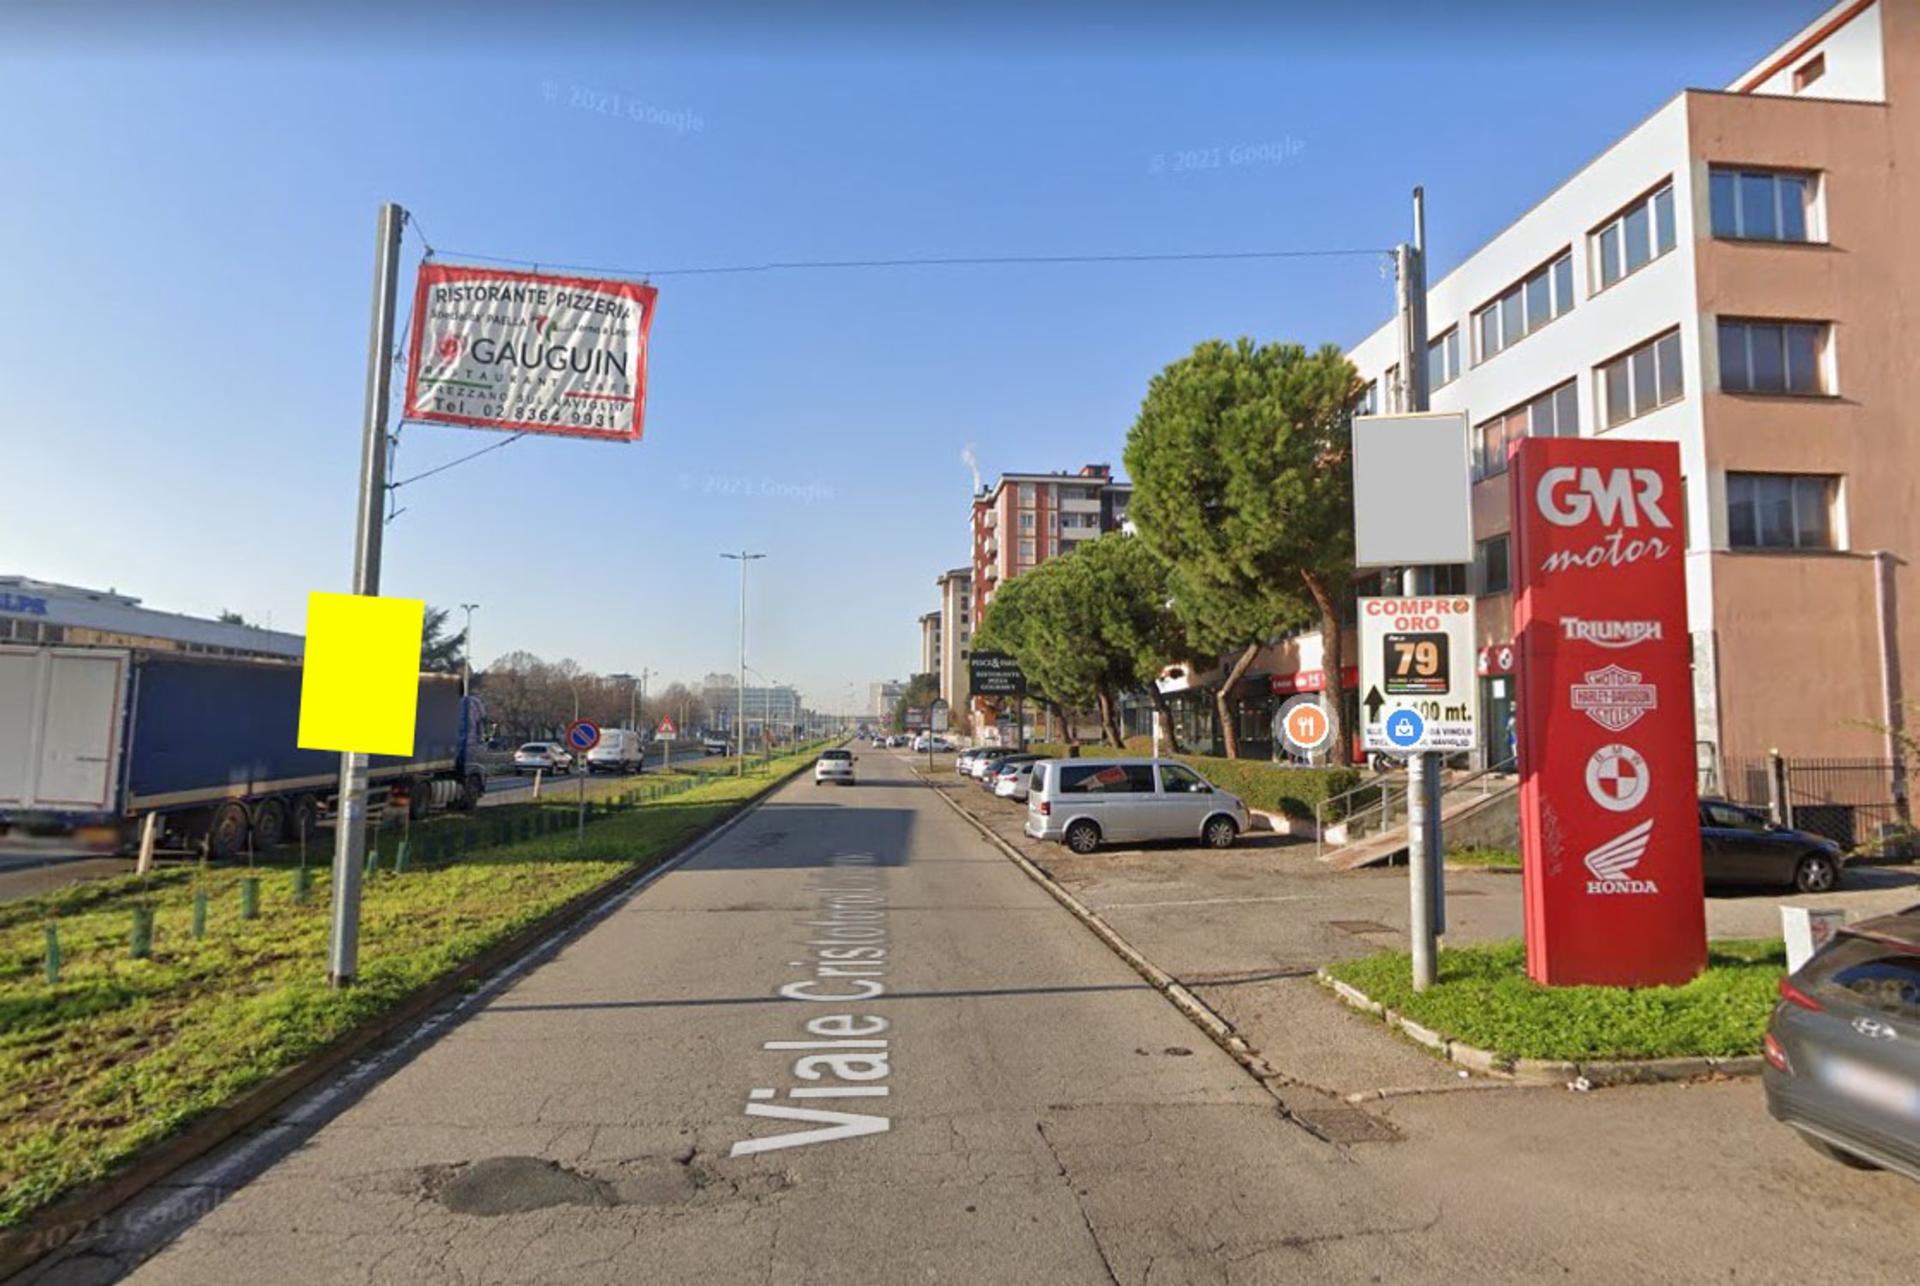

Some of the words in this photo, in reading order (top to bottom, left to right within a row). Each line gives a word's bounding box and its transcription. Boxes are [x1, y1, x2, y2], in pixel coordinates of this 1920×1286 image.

[436, 285, 548, 305] RISTORANTE
[556, 291, 631, 320] PIZZERIA
[471, 338, 628, 378] GAUGUIN
[426, 384, 508, 402] TREZZANO
[552, 398, 625, 412] NAVIGLIO
[434, 397, 472, 415] Tel.
[483, 403, 504, 417] 02
[514, 406, 560, 422] 8364
[571, 411, 616, 428] 9931
[1536, 466, 1673, 528] GMR
[1541, 528, 1671, 572] motor
[1394, 617, 1440, 631] ORO
[1560, 616, 1662, 646] TRIUMPH
[1393, 640, 1439, 676] 79
[1445, 702, 1472, 721] mt.
[1586, 880, 1658, 894] HONDA
